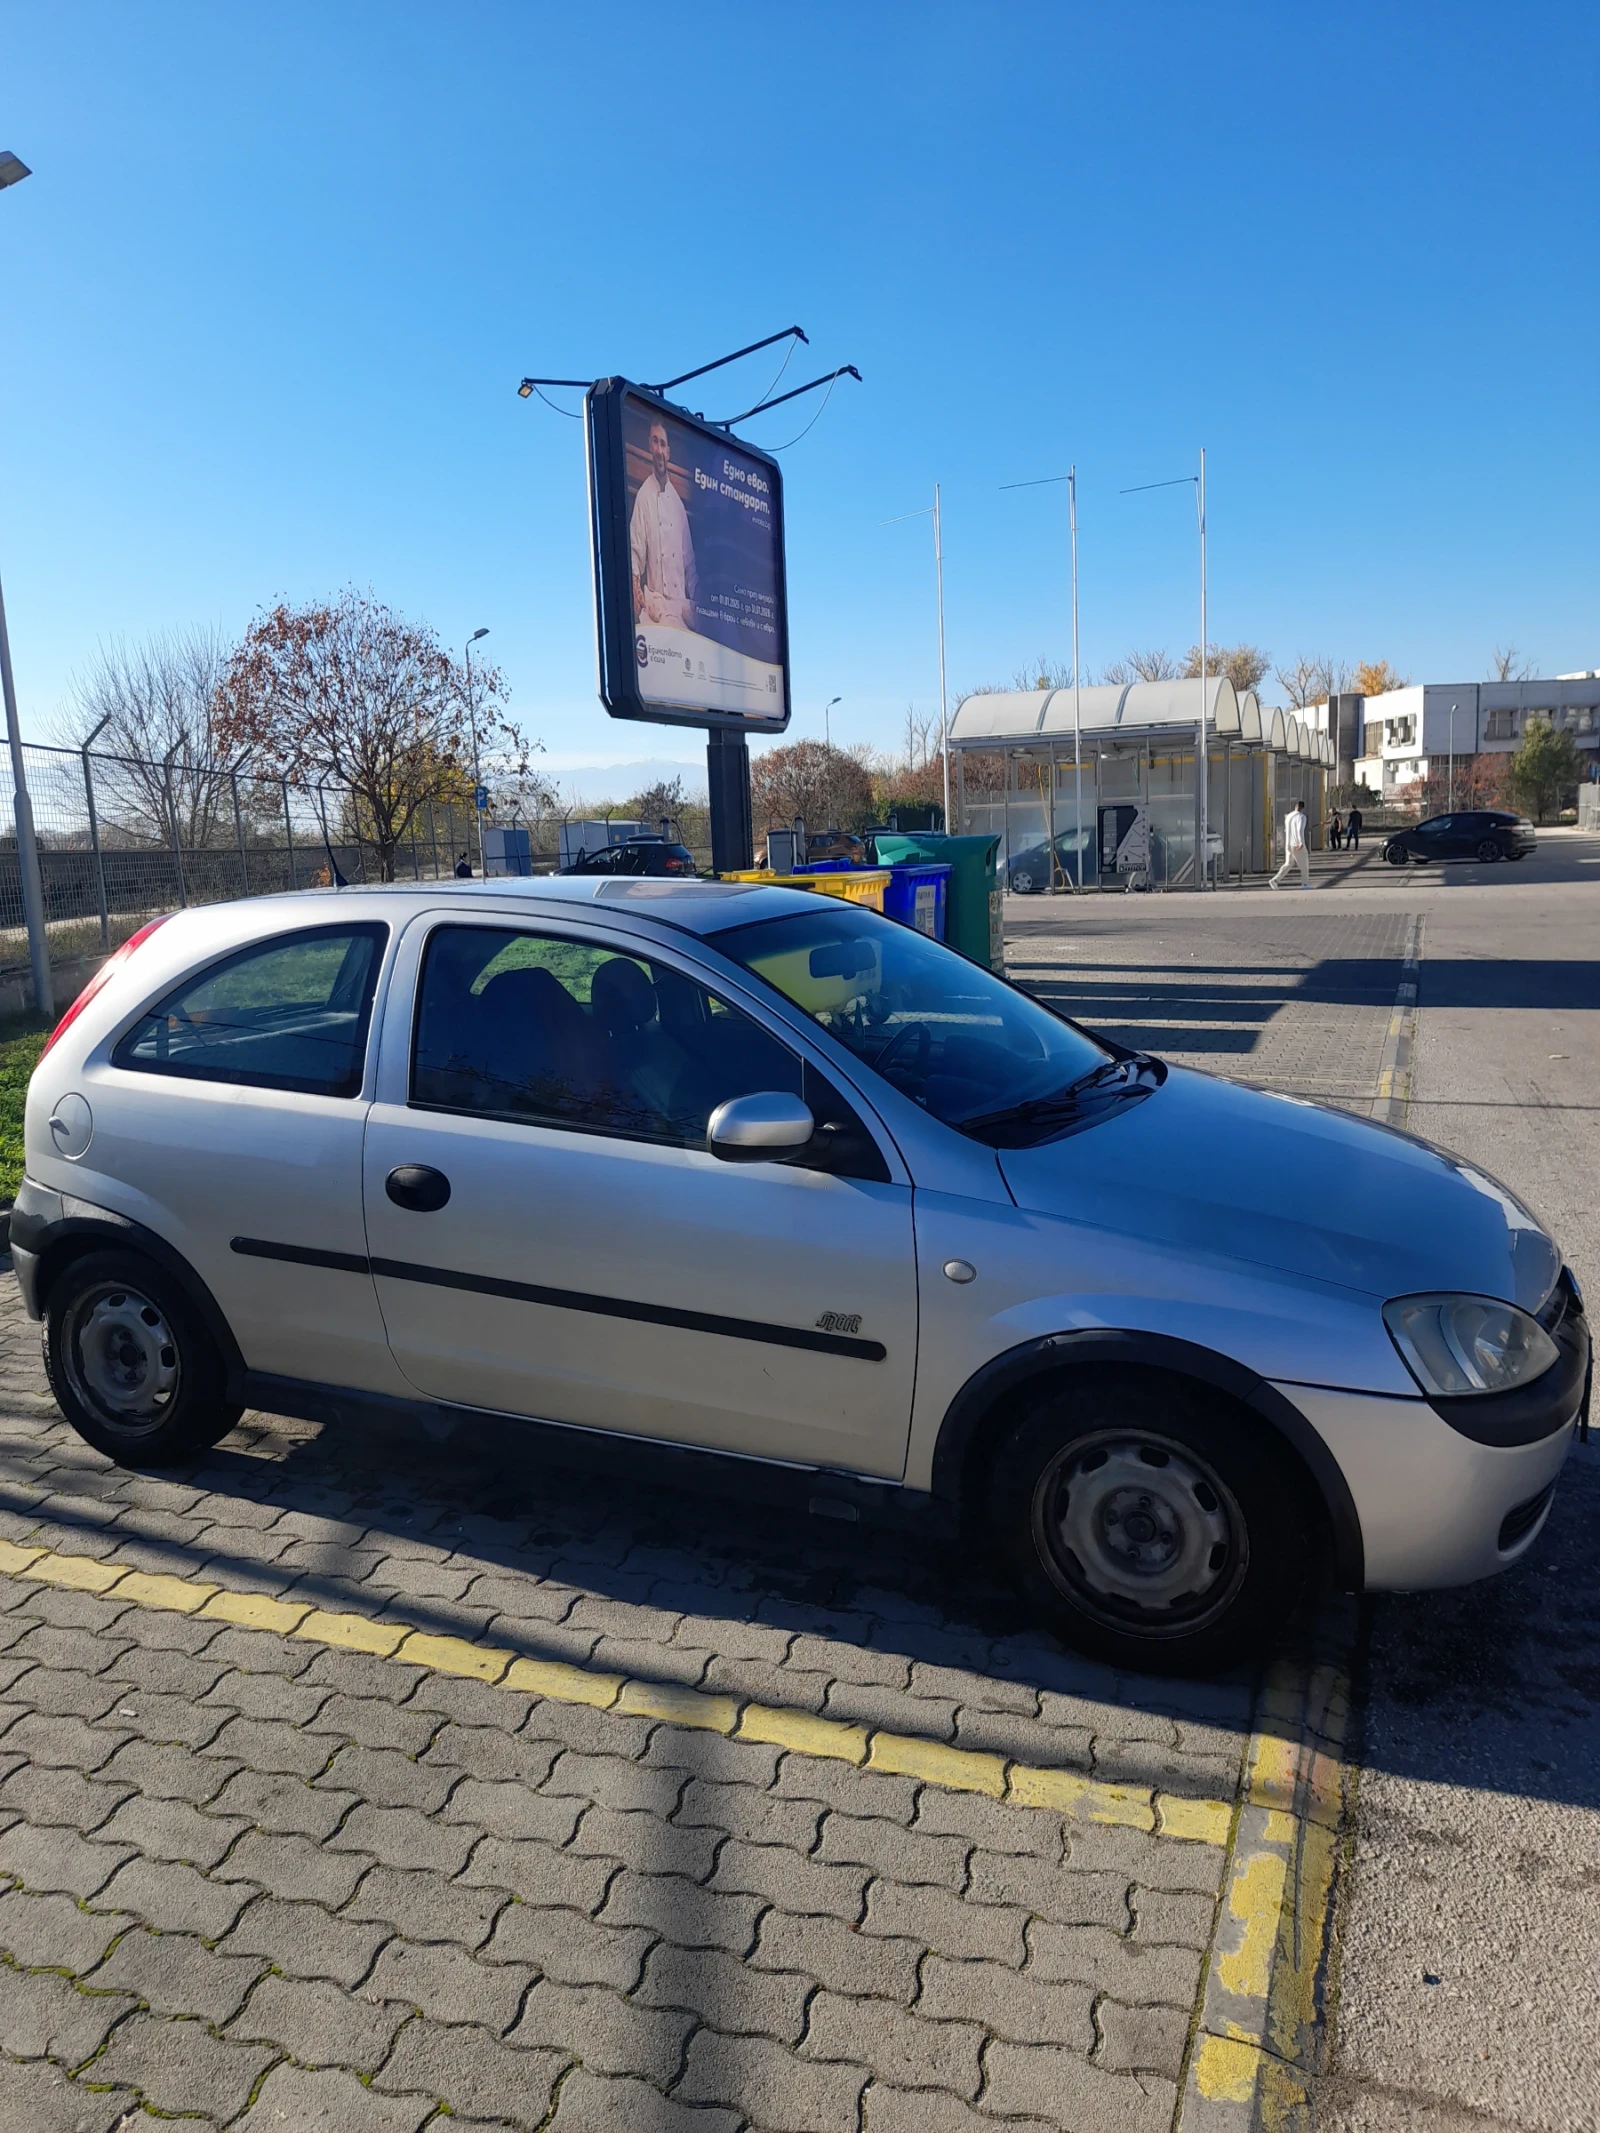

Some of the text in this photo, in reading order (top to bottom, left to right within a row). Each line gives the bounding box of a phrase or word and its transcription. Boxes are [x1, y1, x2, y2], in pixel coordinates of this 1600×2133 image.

[723, 459, 769, 494] Едно евро.
[694, 467, 770, 514] Един стандарт.
[710, 594, 719, 602] от
[723, 611, 736, 624] брой
[648, 644, 682, 659] Единството
[477, 788, 485, 806] P
